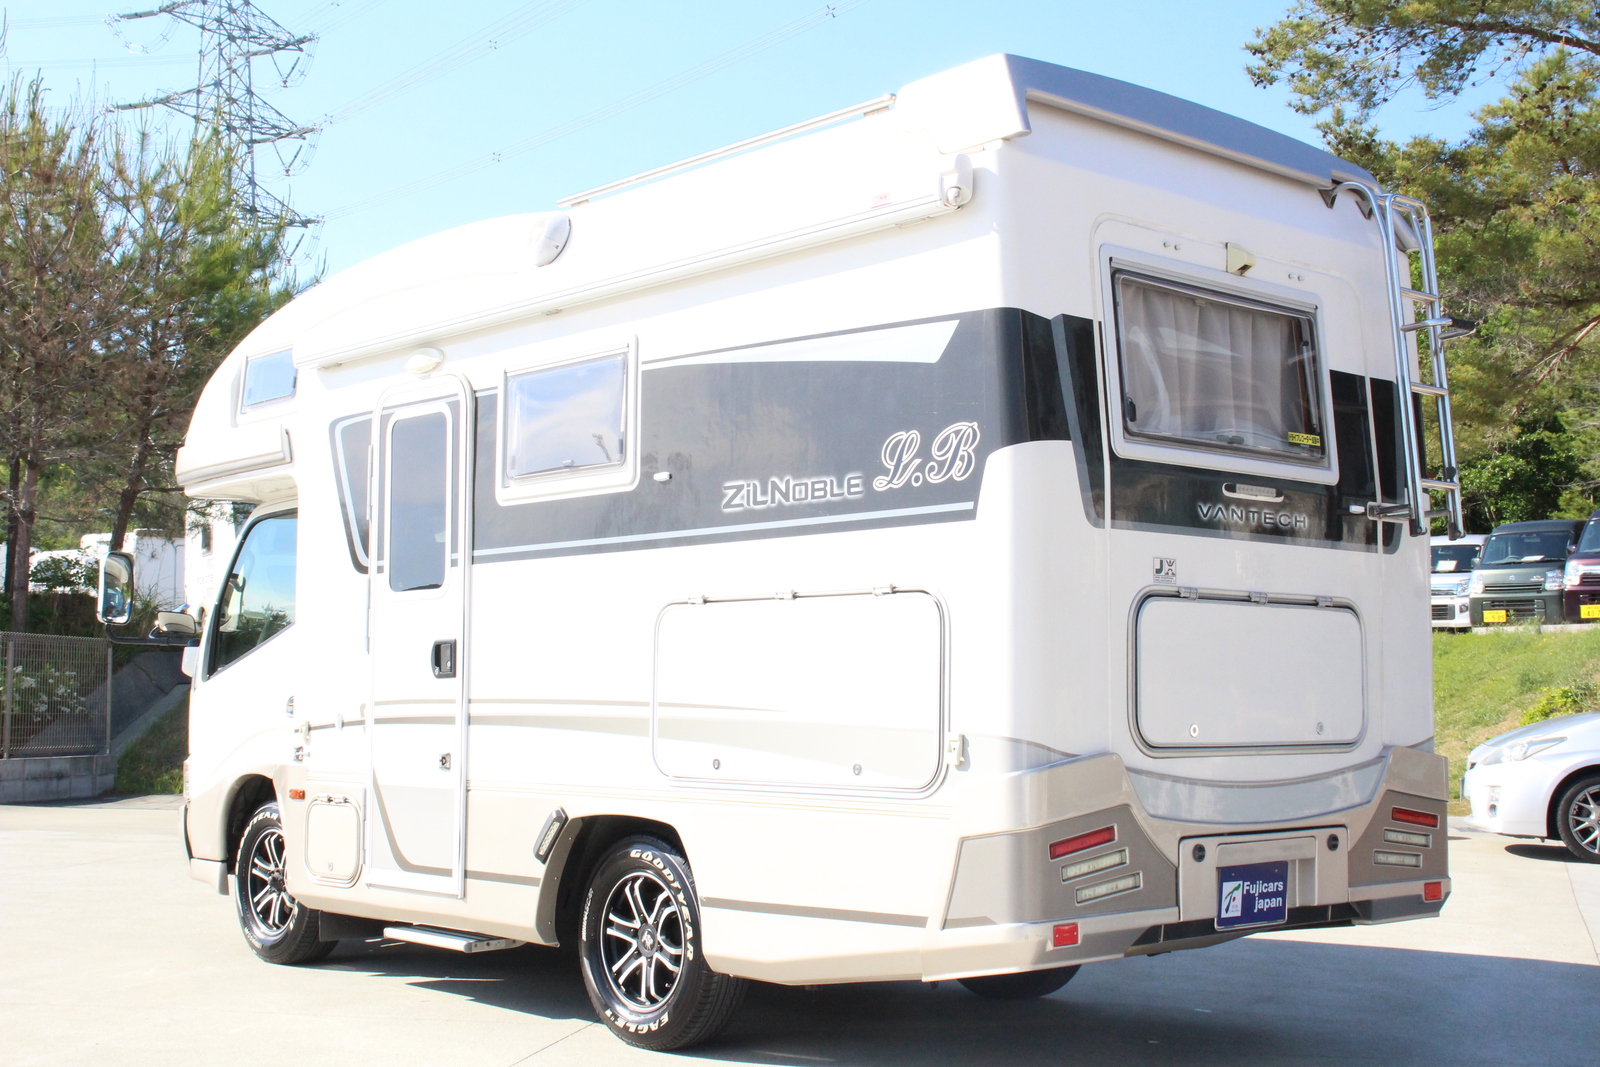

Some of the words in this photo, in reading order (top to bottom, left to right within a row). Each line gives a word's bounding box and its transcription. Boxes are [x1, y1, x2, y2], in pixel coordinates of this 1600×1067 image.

[1198, 504, 1308, 529] VANTECH
[1243, 880, 1284, 897] Fujicars
[630, 849, 694, 961] GOODYEAR
[1253, 896, 1283, 913] japan
[614, 1011, 670, 1035] EAGLE
